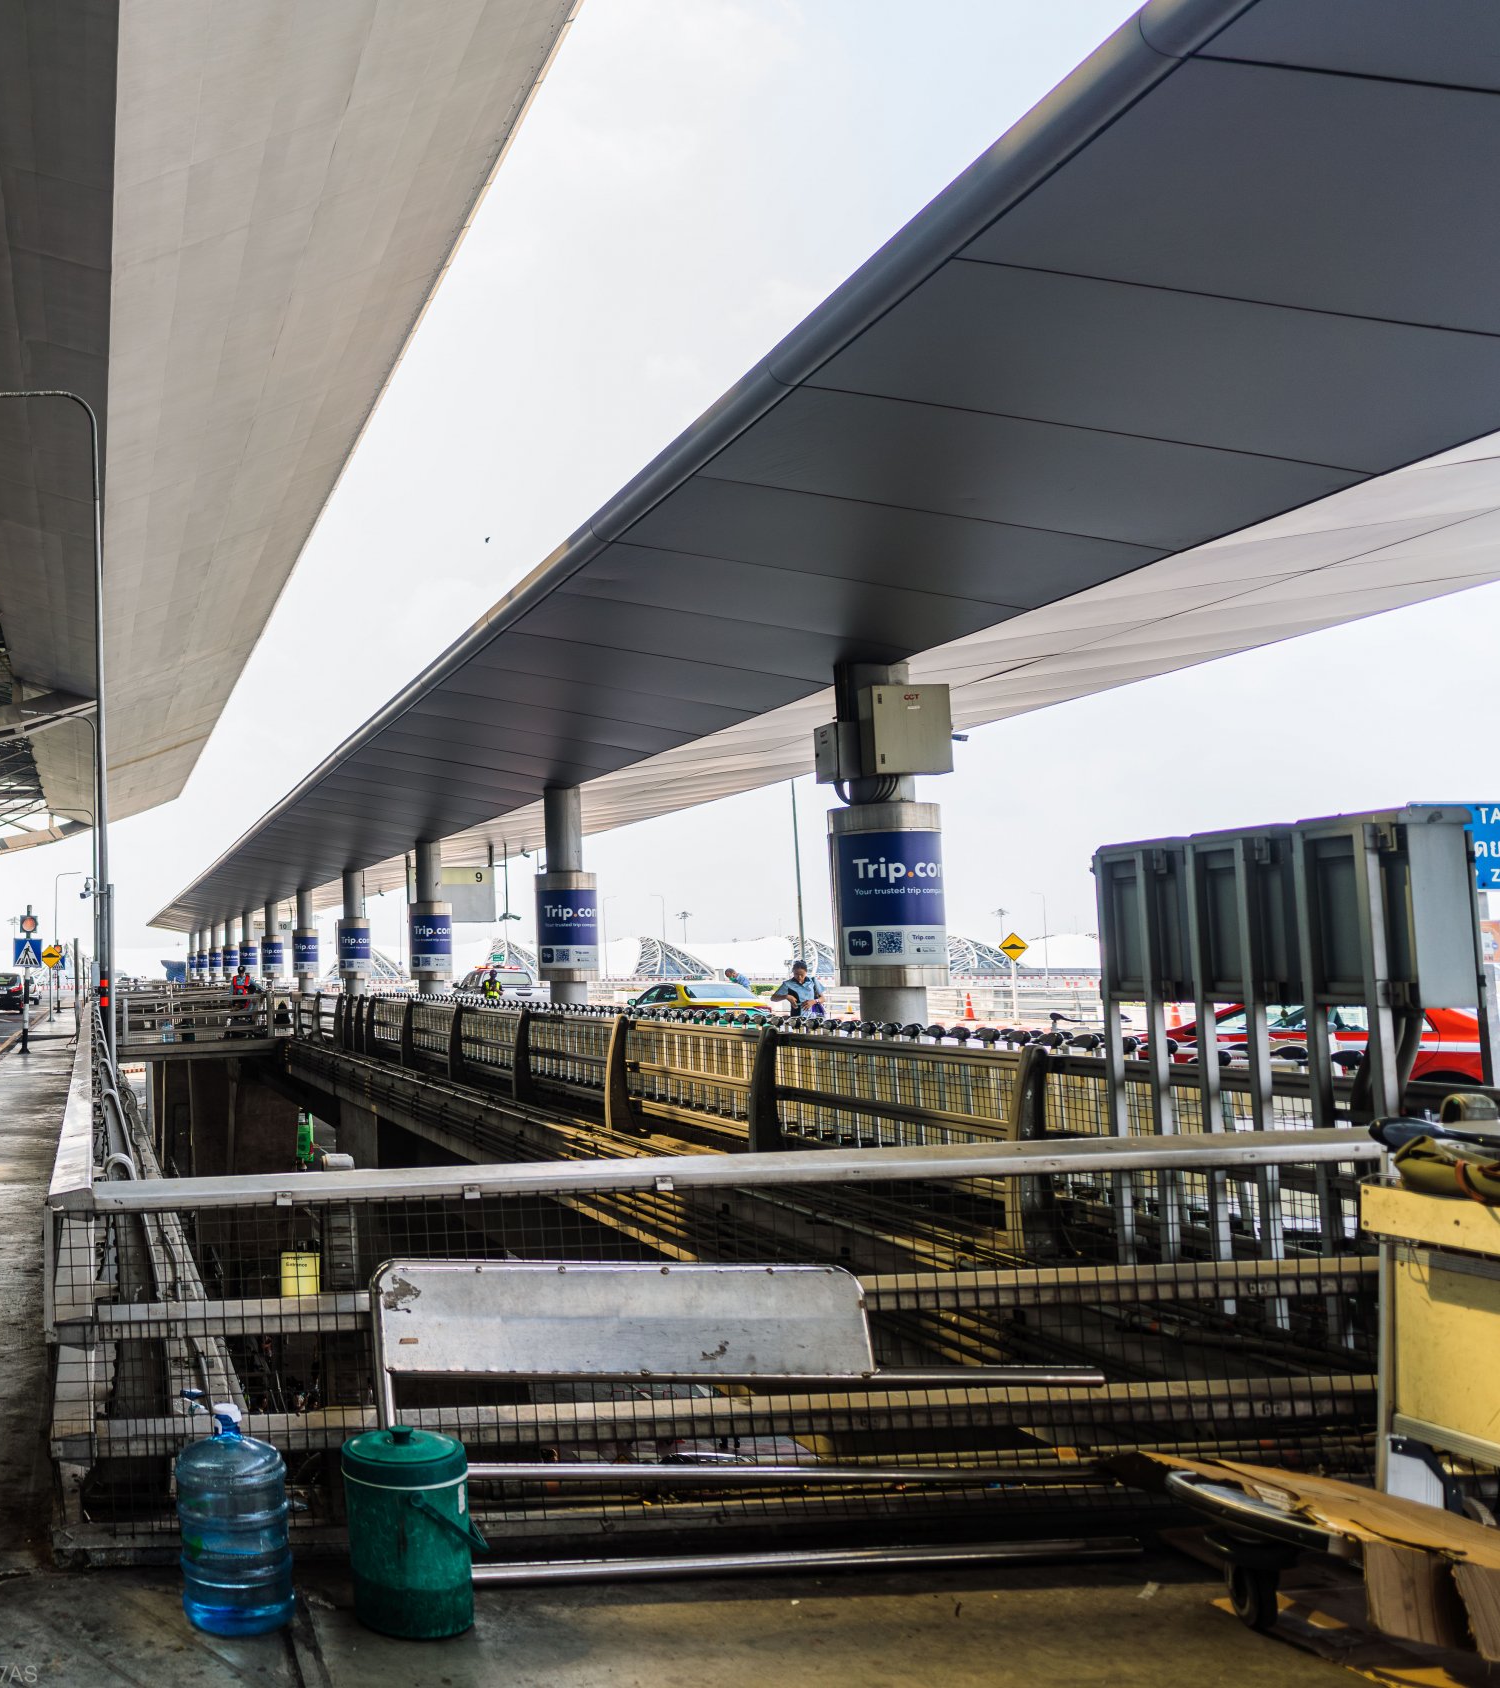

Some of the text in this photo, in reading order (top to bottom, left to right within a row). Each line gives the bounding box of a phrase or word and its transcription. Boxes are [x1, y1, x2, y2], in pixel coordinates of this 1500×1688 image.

[475, 872, 482, 882] 9
[874, 887, 905, 895] trusted
[907, 886, 921, 895] trip
